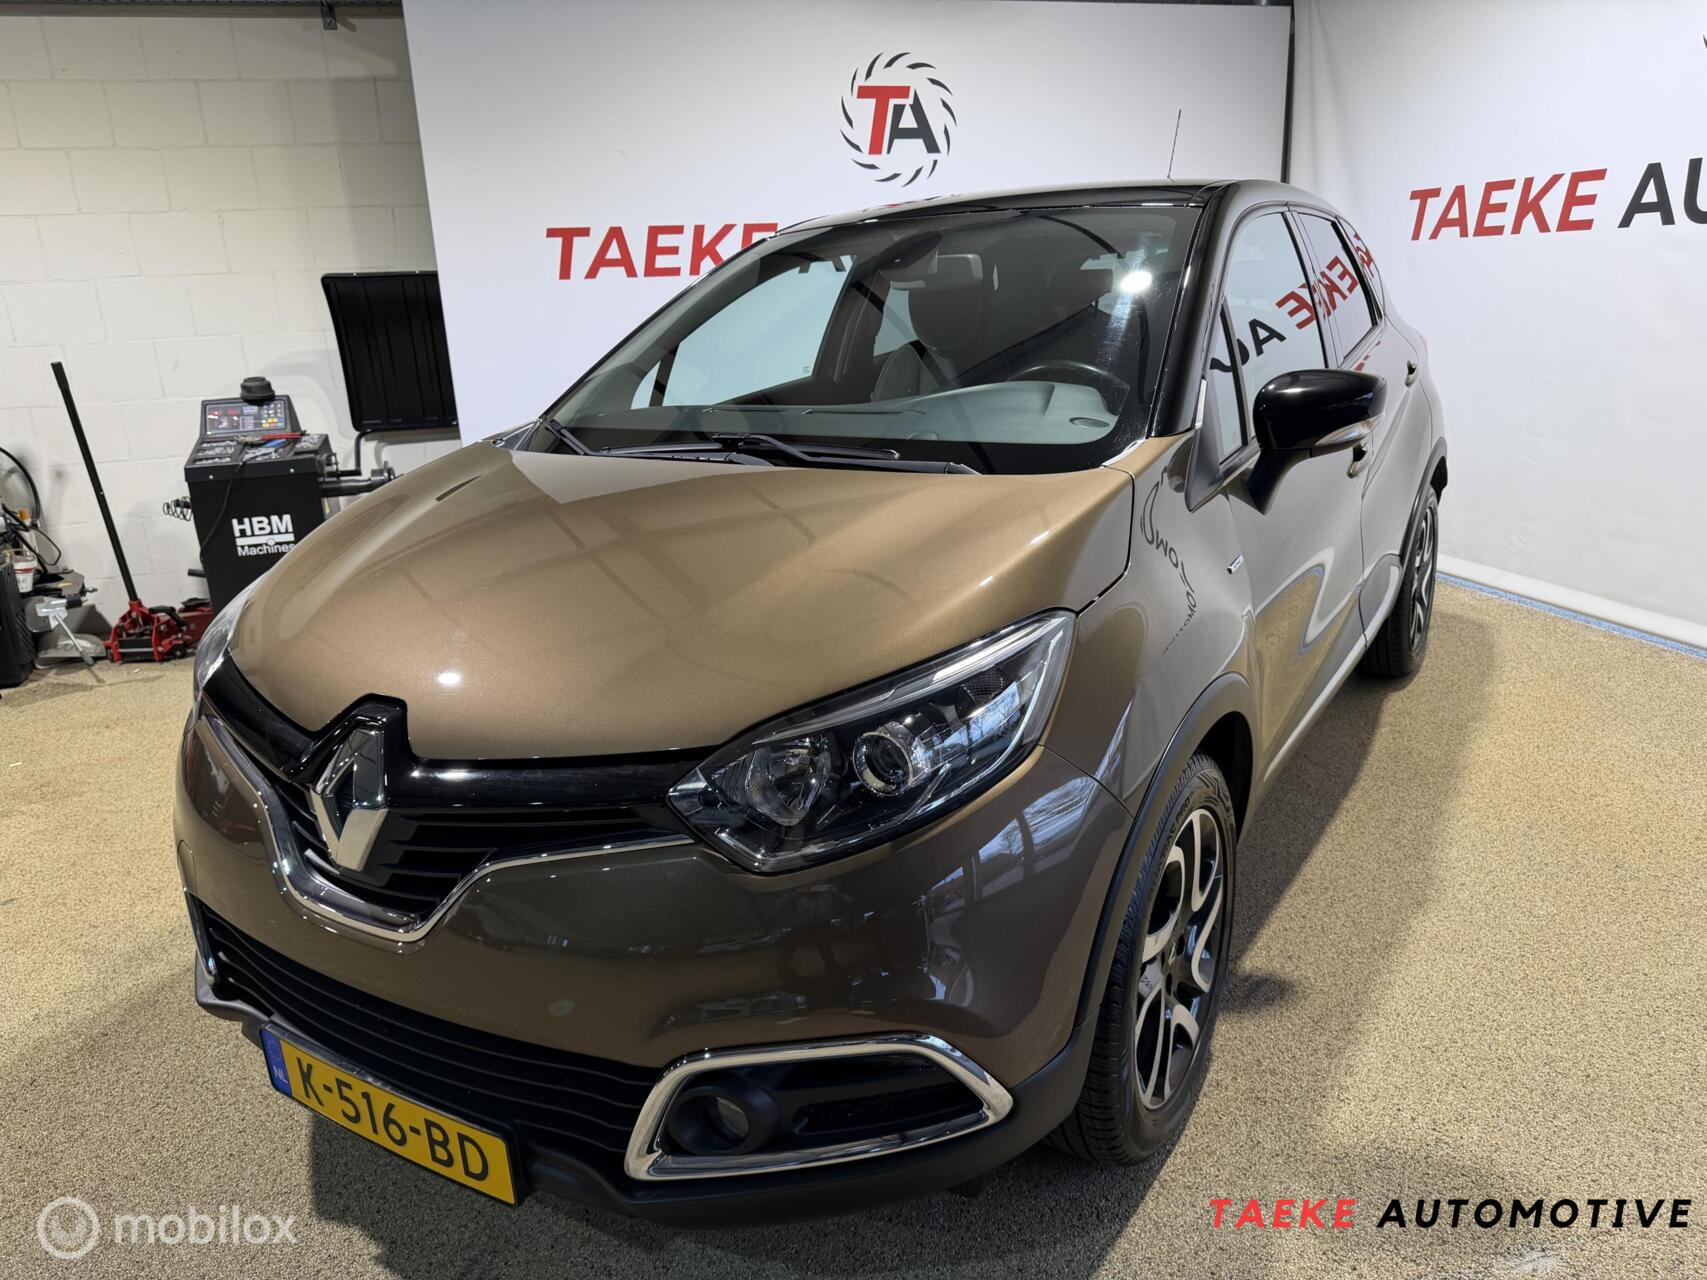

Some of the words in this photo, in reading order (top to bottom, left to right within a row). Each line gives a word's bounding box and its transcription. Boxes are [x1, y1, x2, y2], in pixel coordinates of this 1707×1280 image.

[856, 84, 942, 156] TA
[1409, 167, 1608, 241] TAEKE
[231, 514, 294, 537] HBM
[273, 1064, 289, 1084] NL
[295, 1055, 490, 1182] K-516-BD
